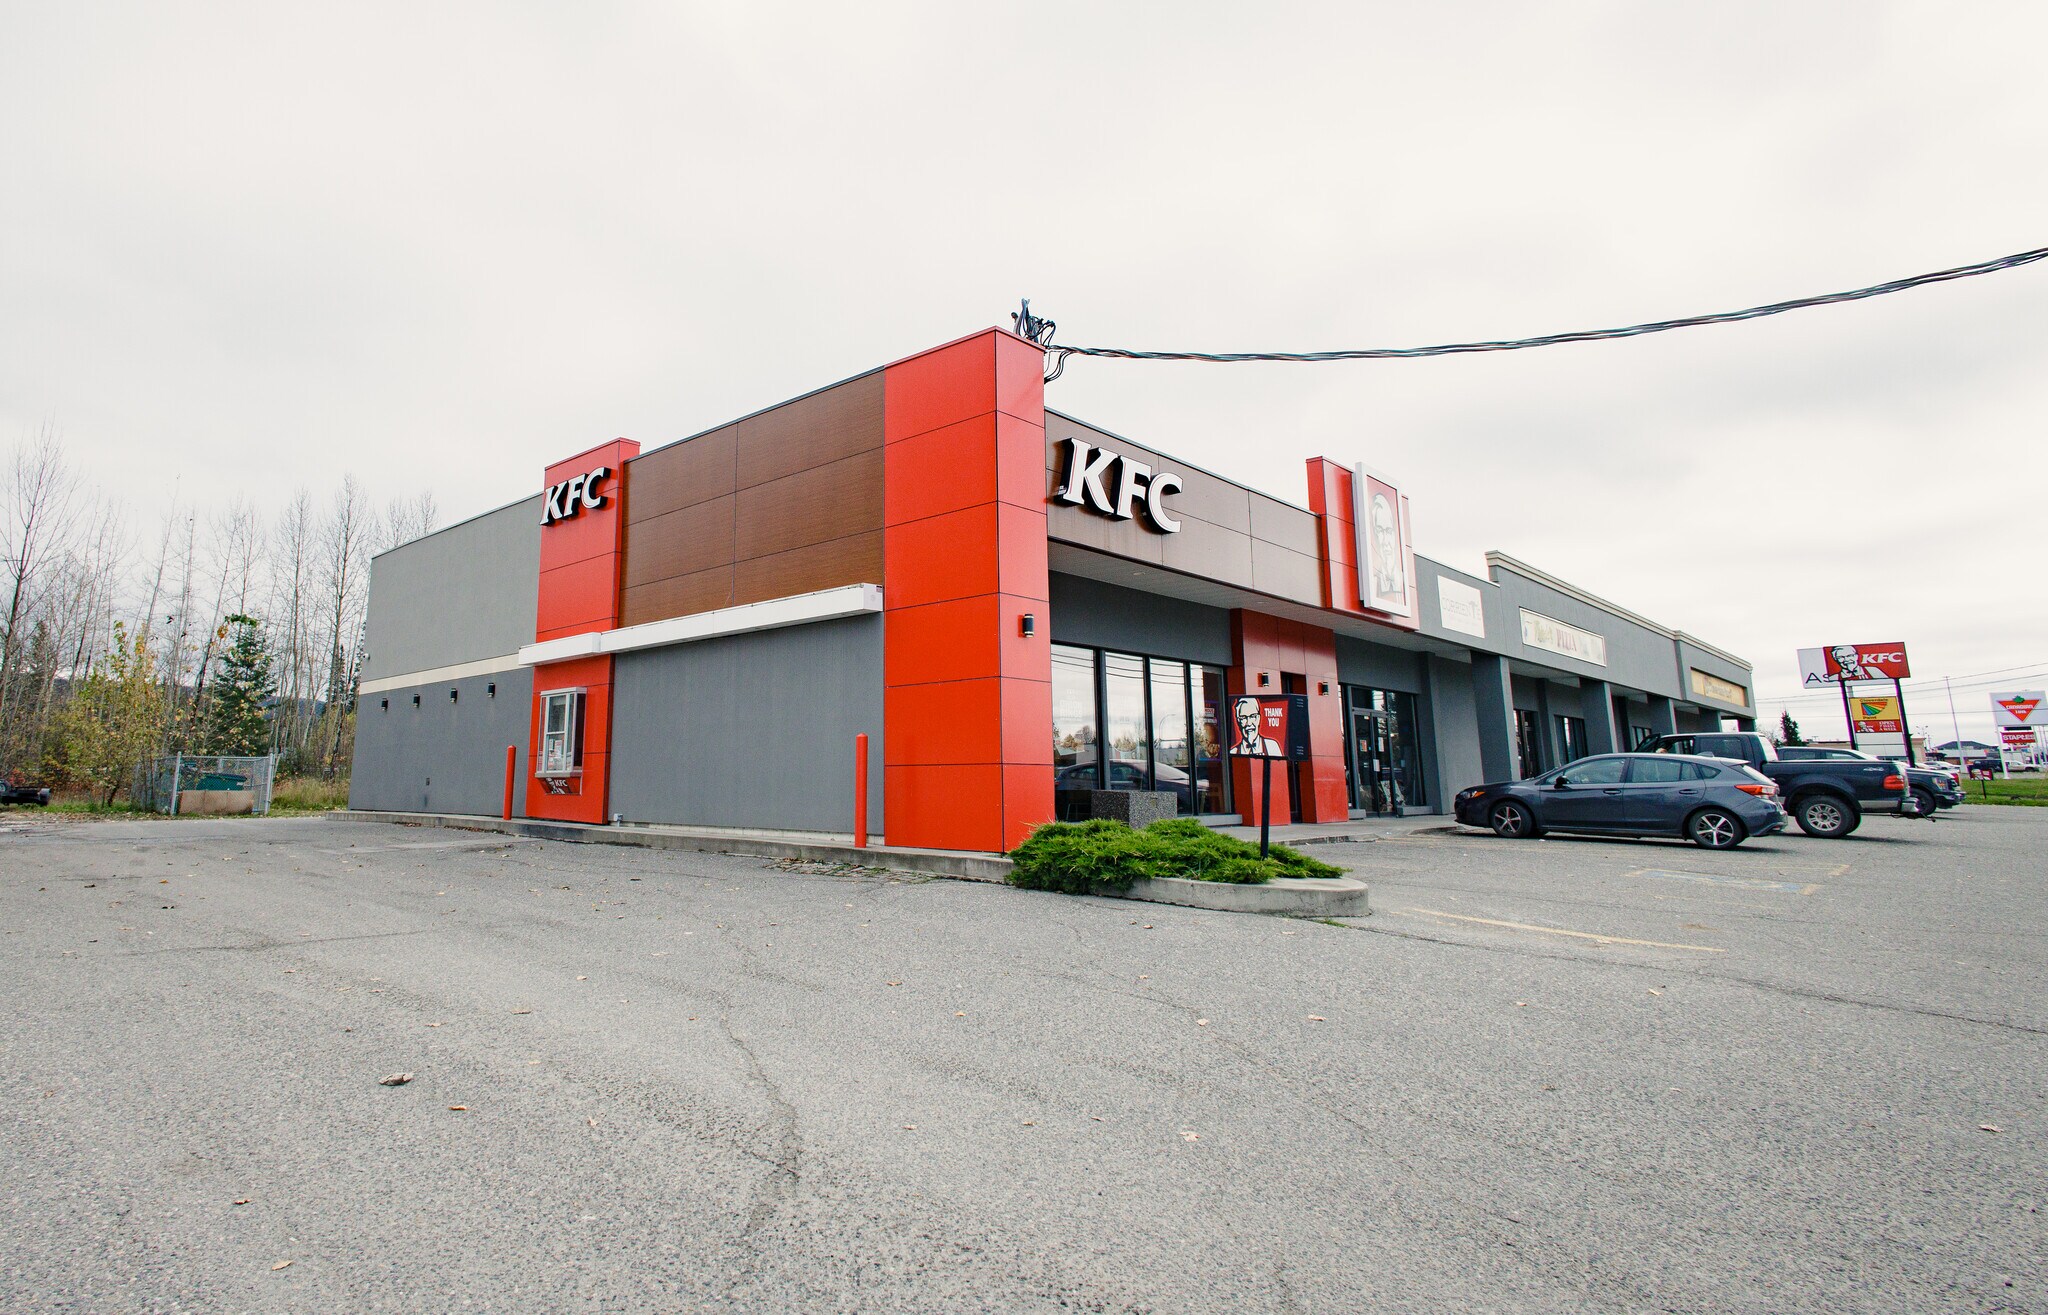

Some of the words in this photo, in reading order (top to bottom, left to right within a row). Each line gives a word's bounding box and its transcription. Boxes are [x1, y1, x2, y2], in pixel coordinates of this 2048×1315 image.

[1057, 437, 1183, 534] KFC
[540, 467, 609, 526] KFC
[1861, 652, 1903, 664] KFC
[1264, 708, 1283, 717] THANK
[1267, 718, 1280, 727] YOU
[554, 779, 568, 787] KFC
